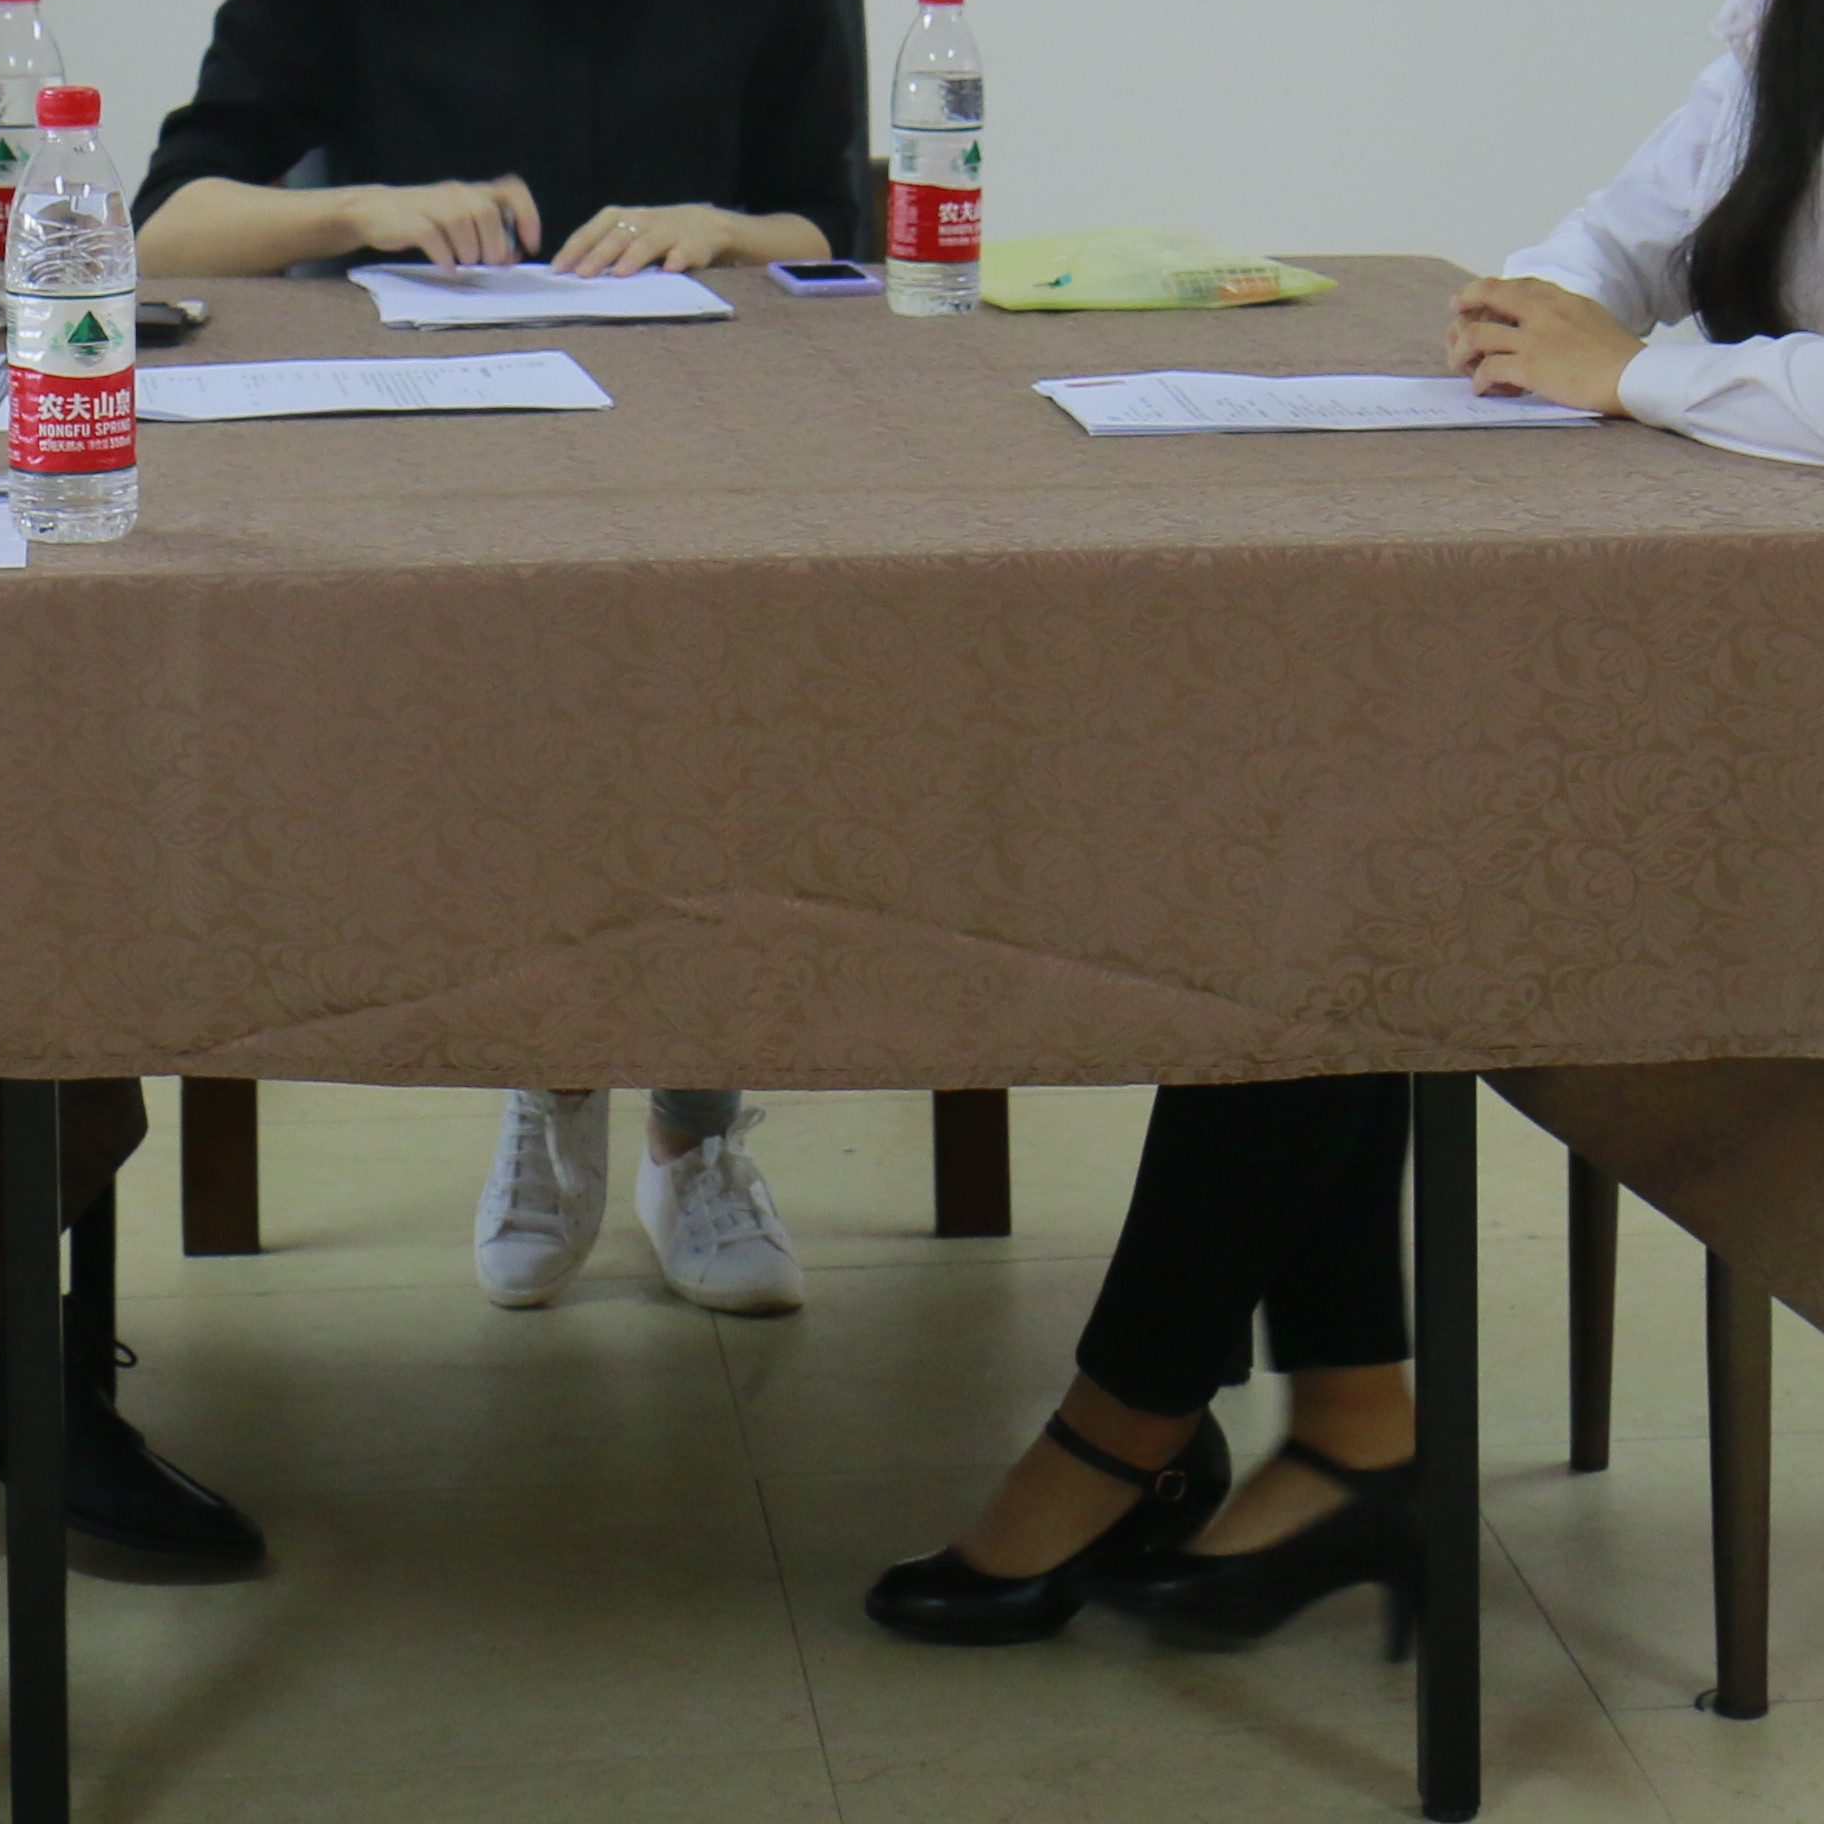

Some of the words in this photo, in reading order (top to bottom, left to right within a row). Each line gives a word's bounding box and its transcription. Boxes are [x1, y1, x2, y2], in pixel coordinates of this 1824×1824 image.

[37, 388, 132, 421] 农夫山泉
[38, 423, 91, 438] NONGFU
[95, 417, 133, 436] SPRING
